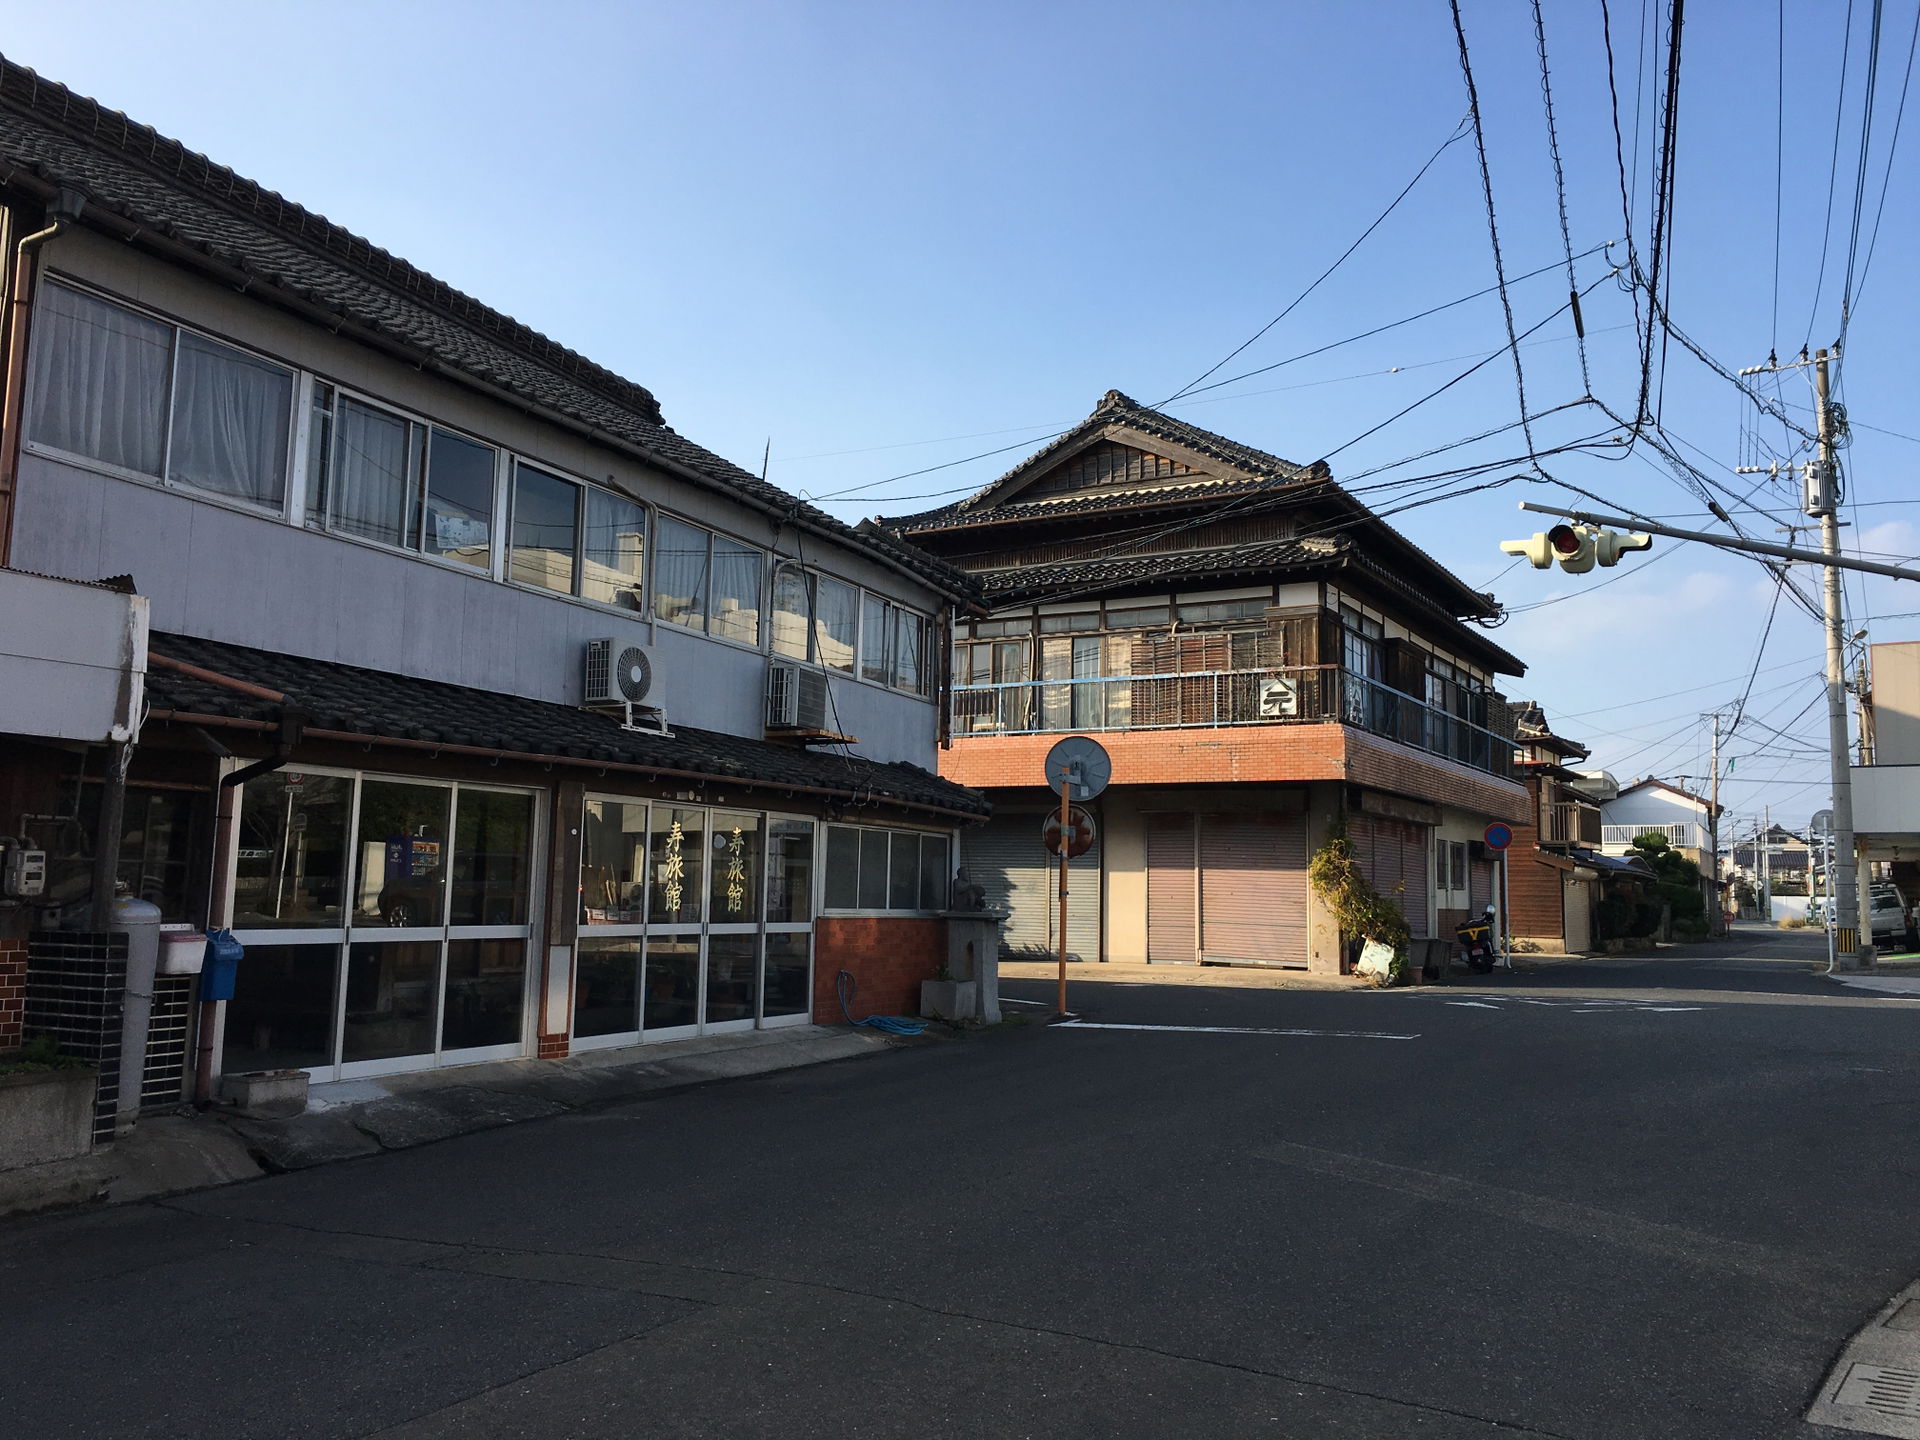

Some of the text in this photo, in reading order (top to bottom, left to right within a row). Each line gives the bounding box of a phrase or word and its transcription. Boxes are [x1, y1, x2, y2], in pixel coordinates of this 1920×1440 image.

[665, 822, 685, 912] 寿旅館
[727, 827, 745, 912] 寿旅館
